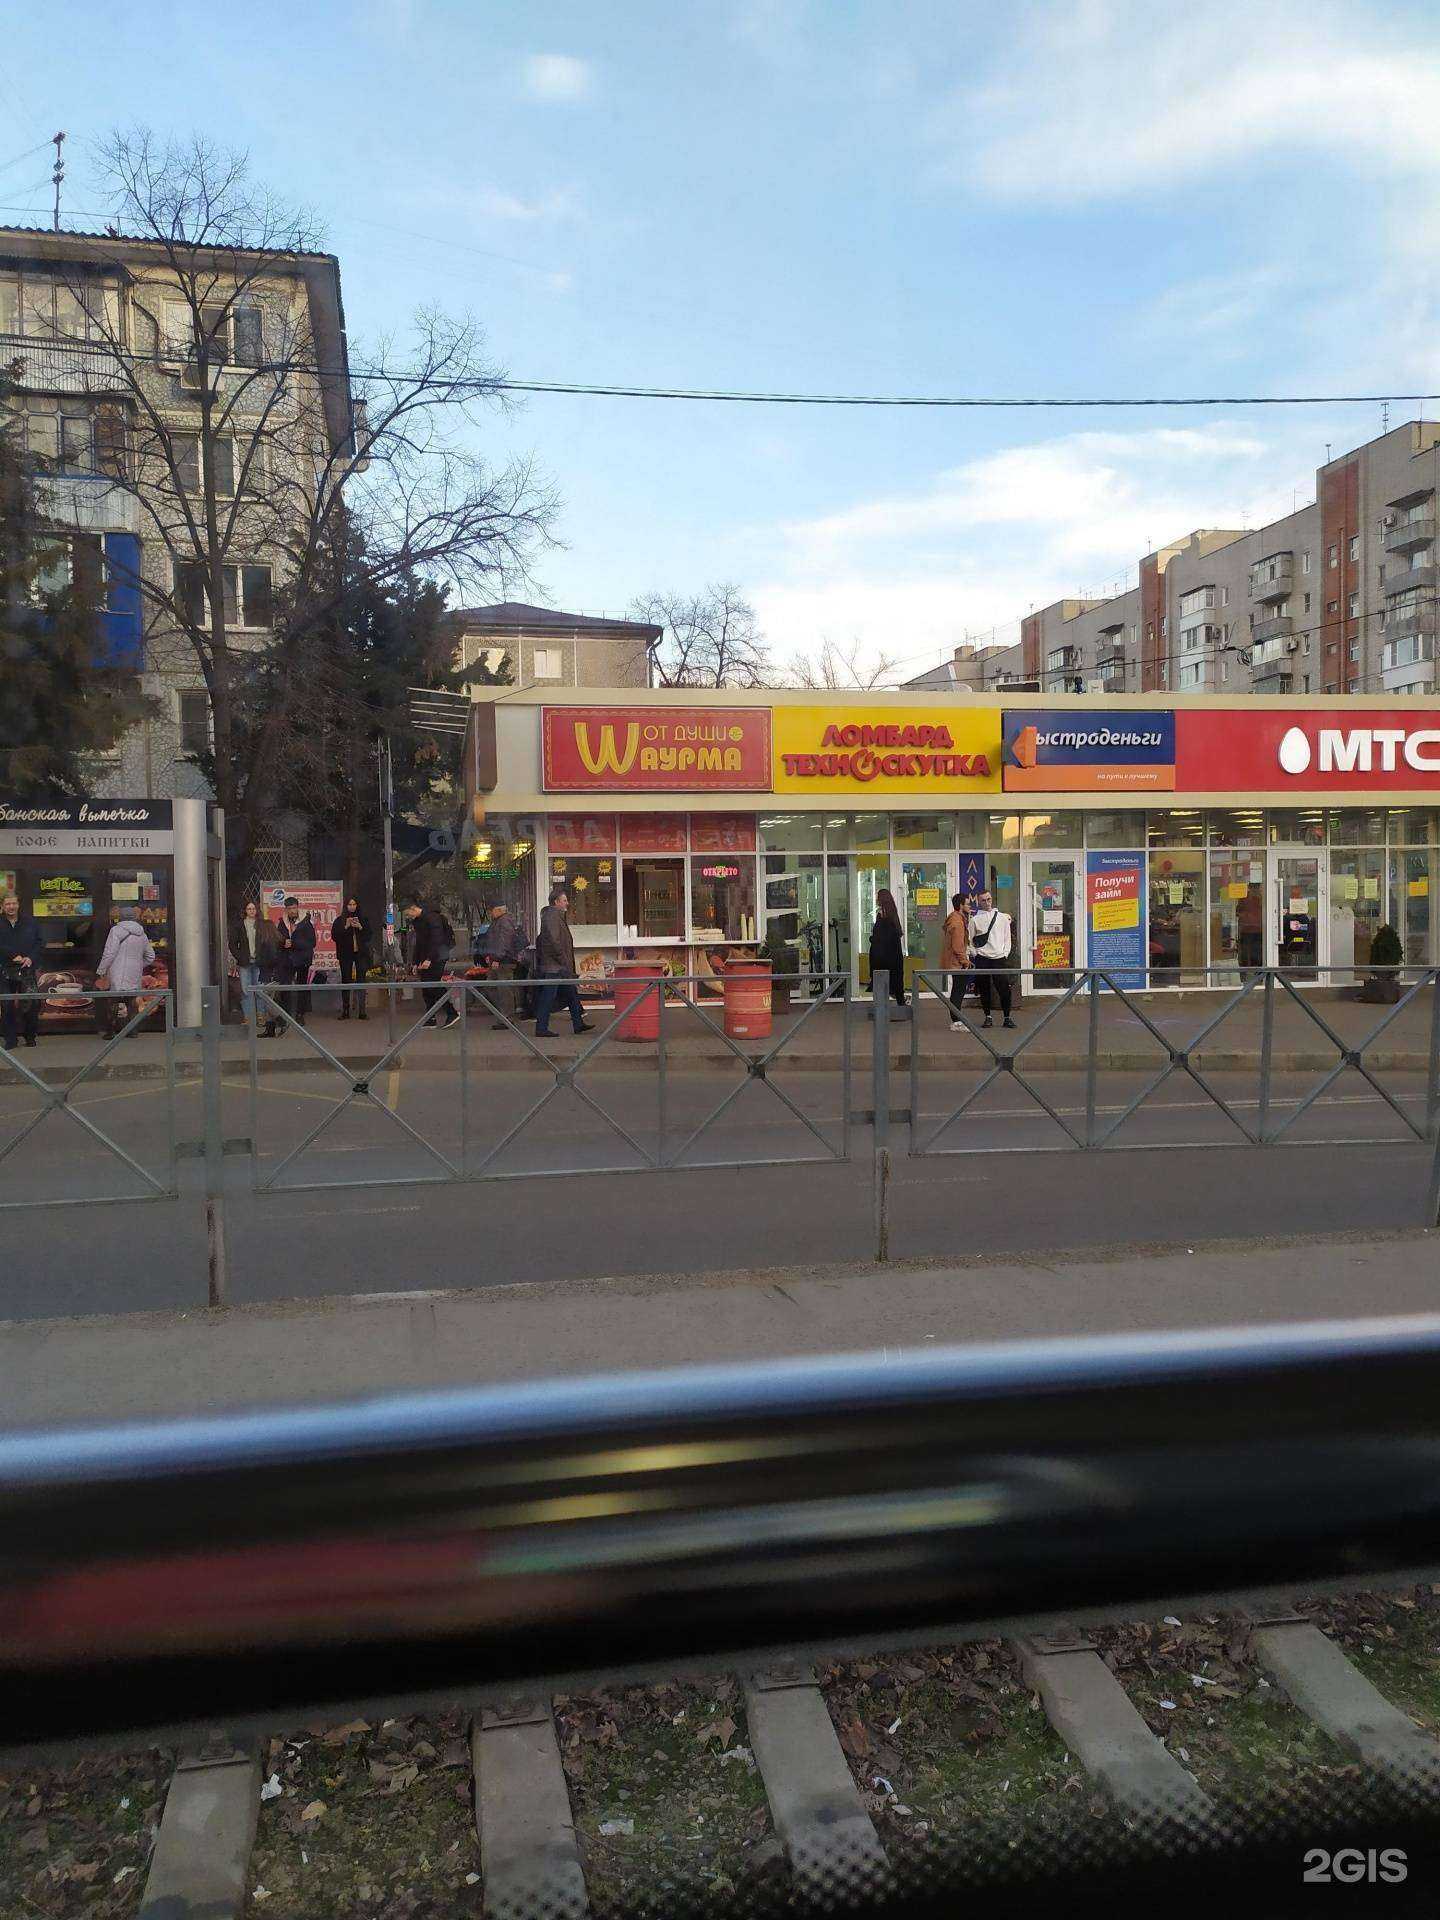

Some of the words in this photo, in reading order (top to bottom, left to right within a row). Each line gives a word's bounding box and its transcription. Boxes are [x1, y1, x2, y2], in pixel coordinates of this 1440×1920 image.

[643, 725, 668, 741] ОТ
[674, 725, 727, 741] ДУШИ
[821, 725, 954, 749] ЛОМБАРД
[1034, 728, 1162, 749] ыстроденьги
[1319, 729, 1440, 771] МТС
[78, 803, 149, 822] выпечка
[15, 836, 57, 847] КОФЕ
[77, 837, 150, 848] НАПИТКИ
[1095, 876, 1135, 888] Получи
[1095, 889, 1122, 899] займ
